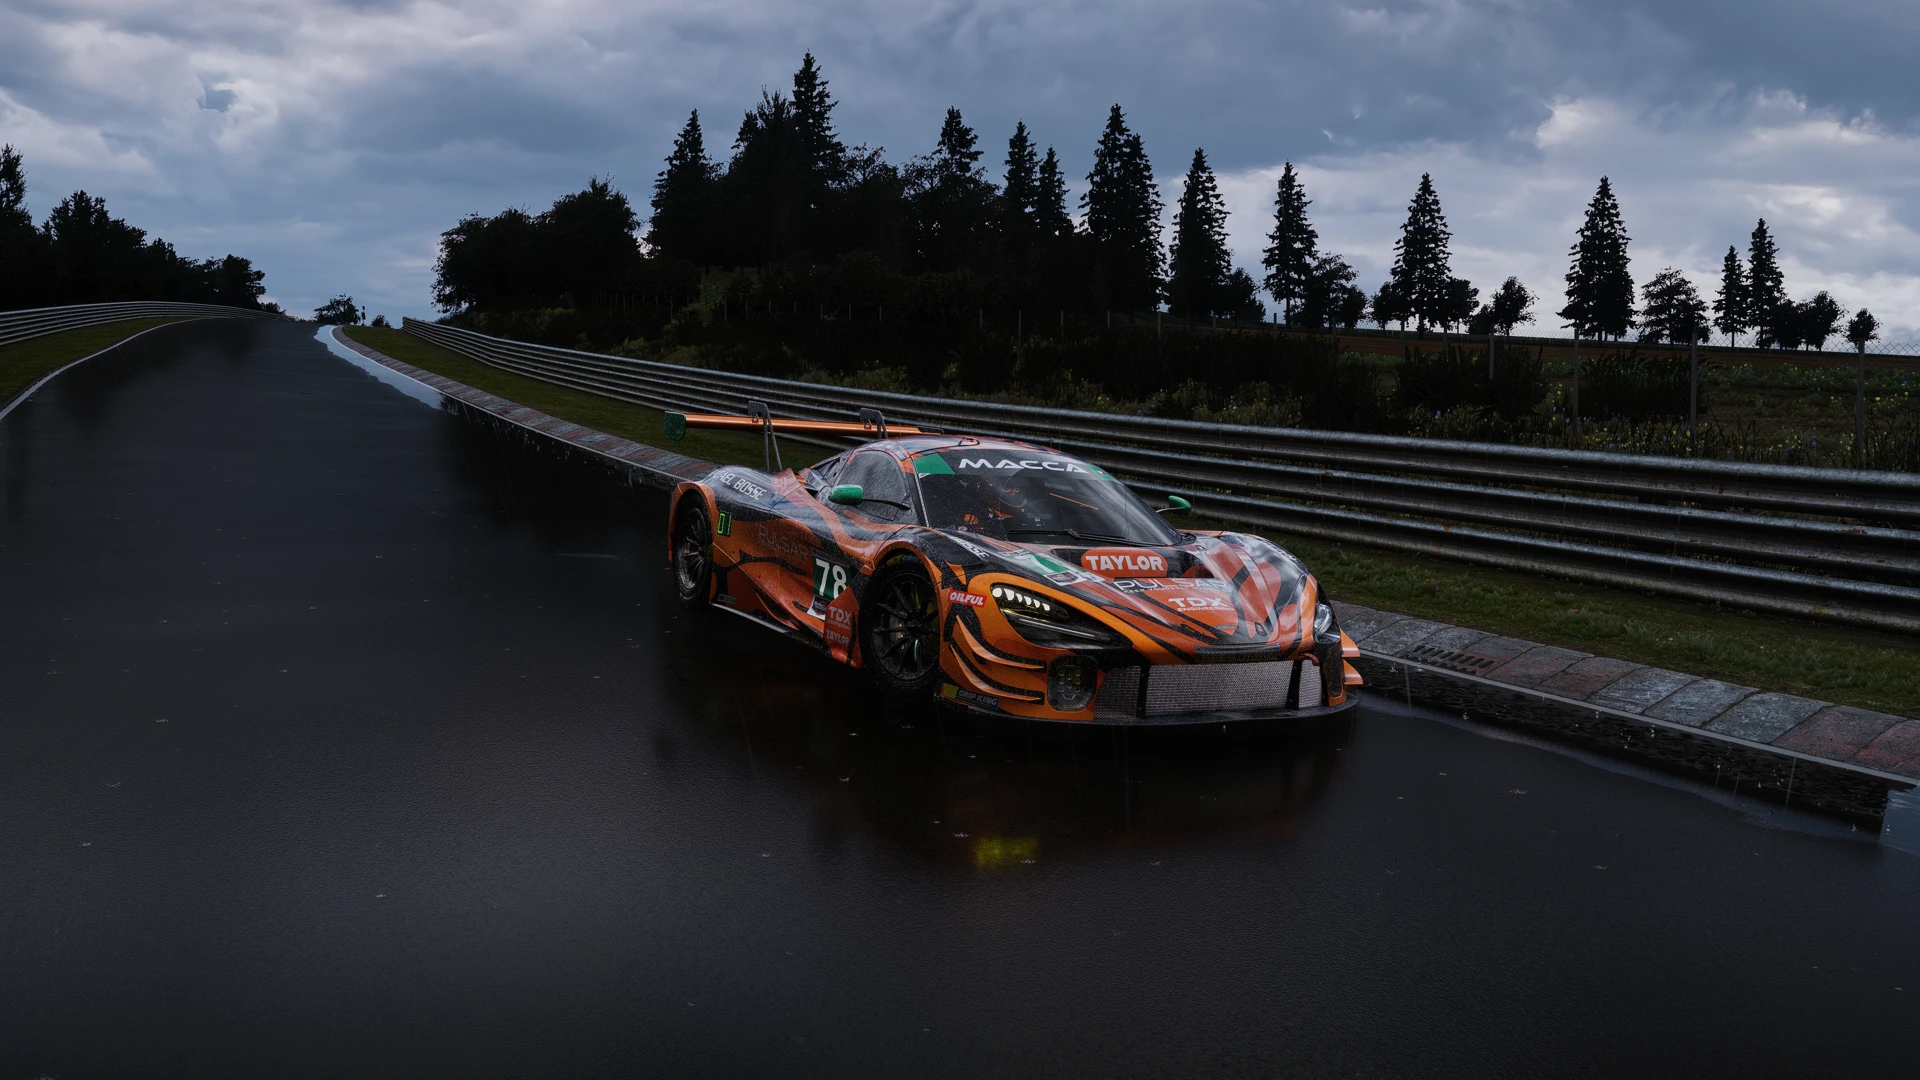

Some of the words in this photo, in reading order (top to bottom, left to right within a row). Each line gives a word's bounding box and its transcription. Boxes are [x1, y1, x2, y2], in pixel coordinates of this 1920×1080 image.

[959, 458, 1090, 475] MACCA
[733, 478, 767, 501] BOSSE
[1085, 555, 1165, 572] TAYLOR
[815, 557, 847, 600] 78
[949, 591, 984, 606] OILFUL
[1168, 597, 1230, 608] TDX
[828, 605, 853, 625] TDX
[826, 629, 850, 645] TAYLOR
[958, 689, 977, 700] GRIP
[976, 694, 998, 706] KING
